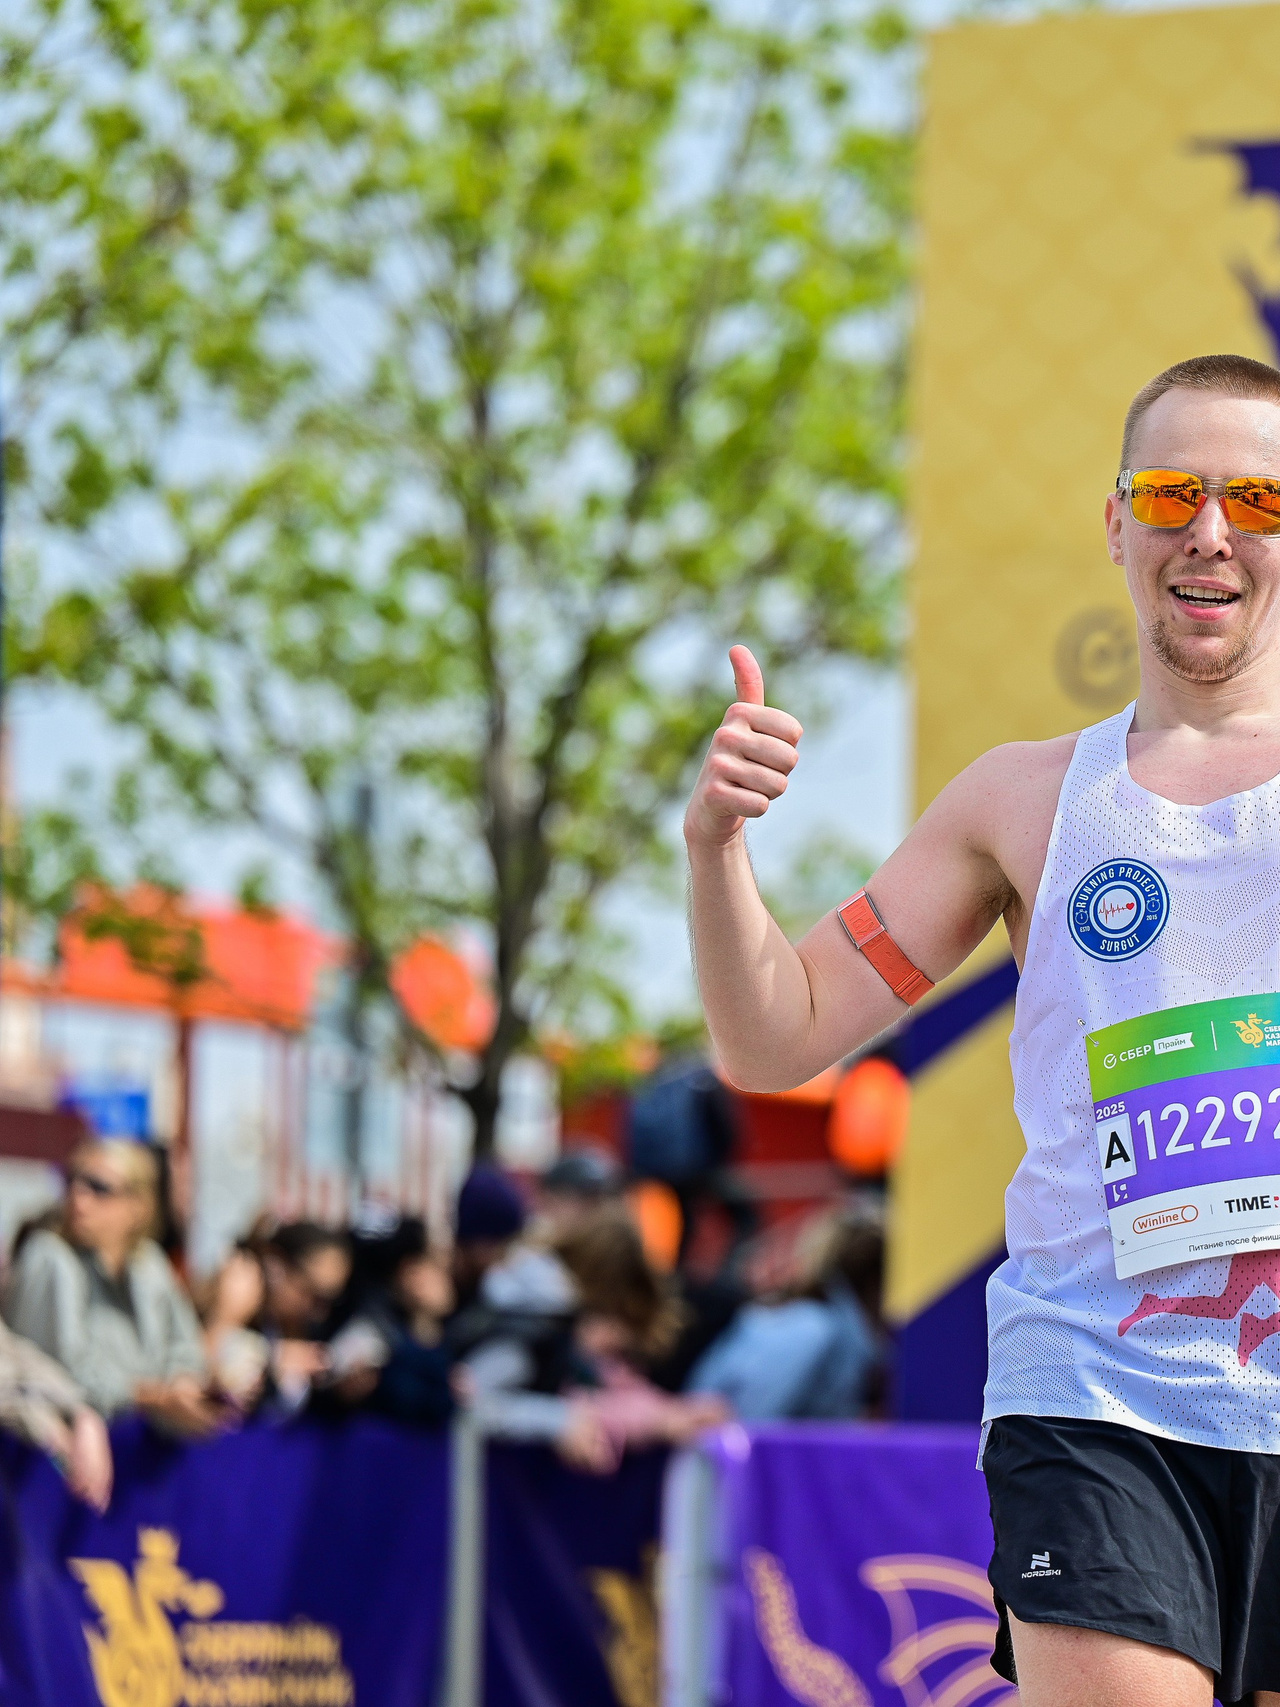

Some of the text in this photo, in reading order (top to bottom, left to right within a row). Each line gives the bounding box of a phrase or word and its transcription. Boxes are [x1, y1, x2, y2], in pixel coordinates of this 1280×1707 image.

[1075, 866, 1159, 908] RUNNING PROJECT
[1100, 933, 1140, 952] SURGUT
[1119, 1038, 1186, 1062] СБЕР Прайм
[1096, 1101, 1126, 1120] 2025
[1104, 1131, 1131, 1170] A
[1137, 1212, 1179, 1230] Winline
[1188, 1240, 1224, 1252] Питание
[1225, 1236, 1250, 1247] после
[1021, 1569, 1062, 1579] NORDSKI
